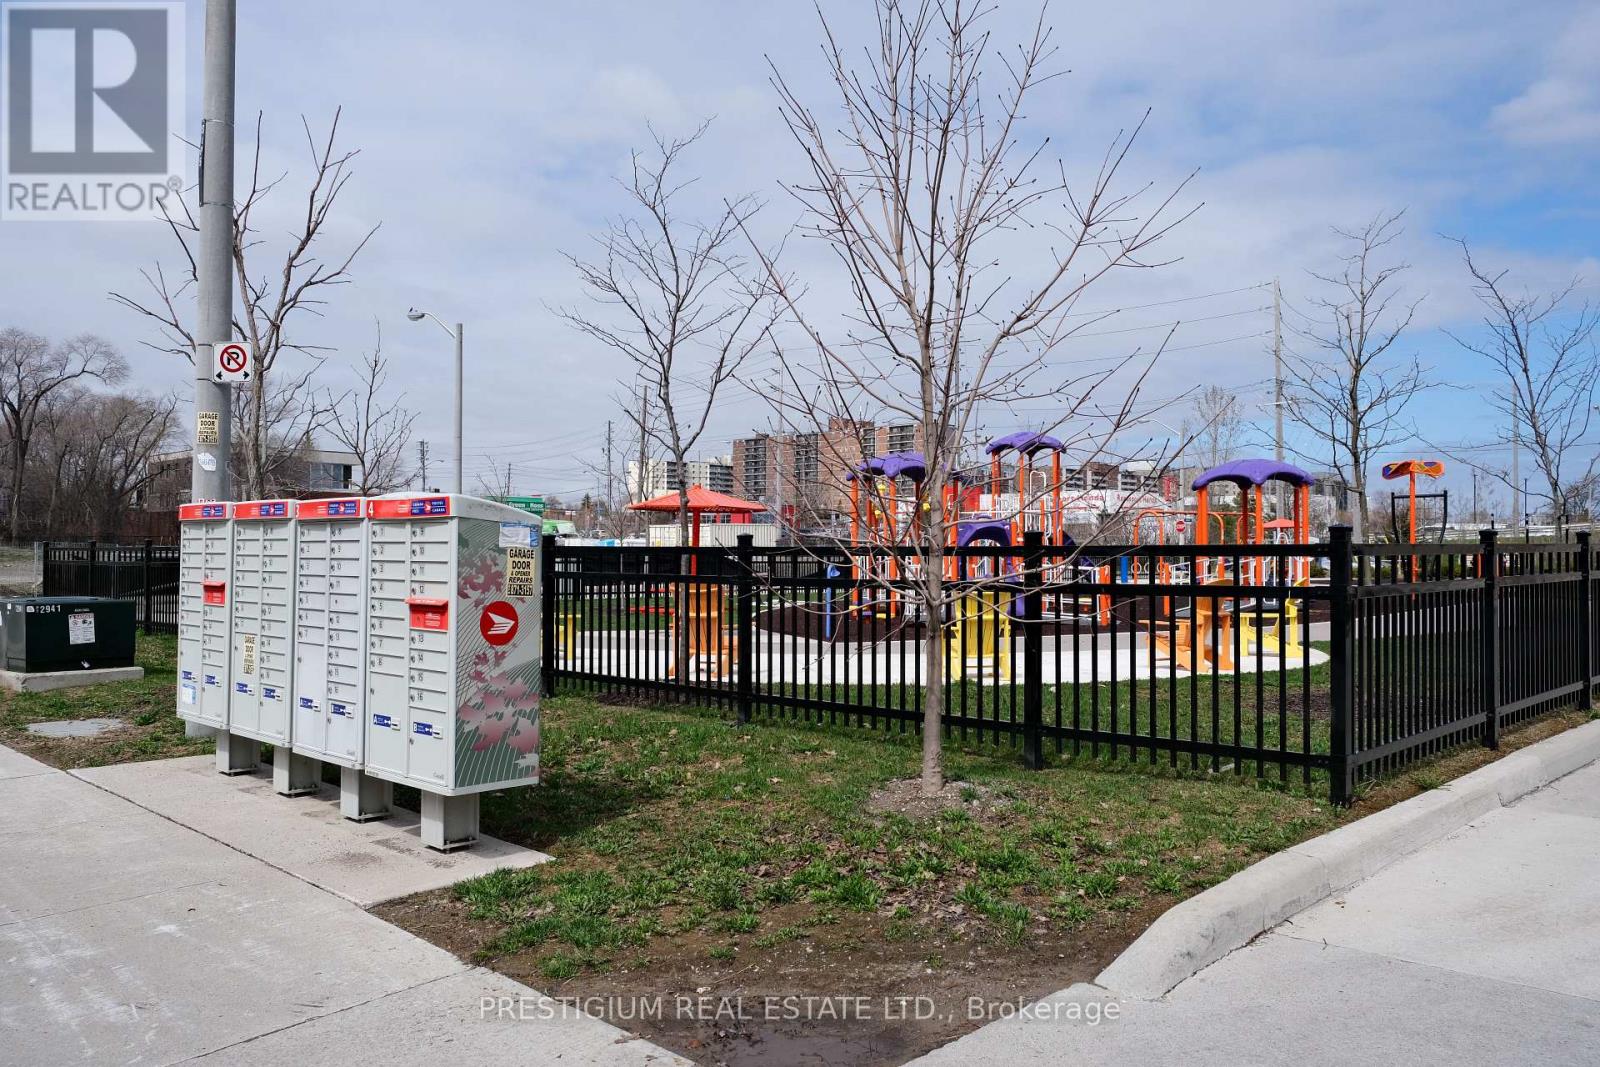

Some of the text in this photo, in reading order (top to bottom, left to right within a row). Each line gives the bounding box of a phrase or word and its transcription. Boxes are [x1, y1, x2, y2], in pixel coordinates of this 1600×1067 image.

[368, 502, 374, 516] 4
[509, 549, 534, 560] GARAGE
[512, 560, 530, 570] DOOR
[40, 604, 61, 614] 2941
